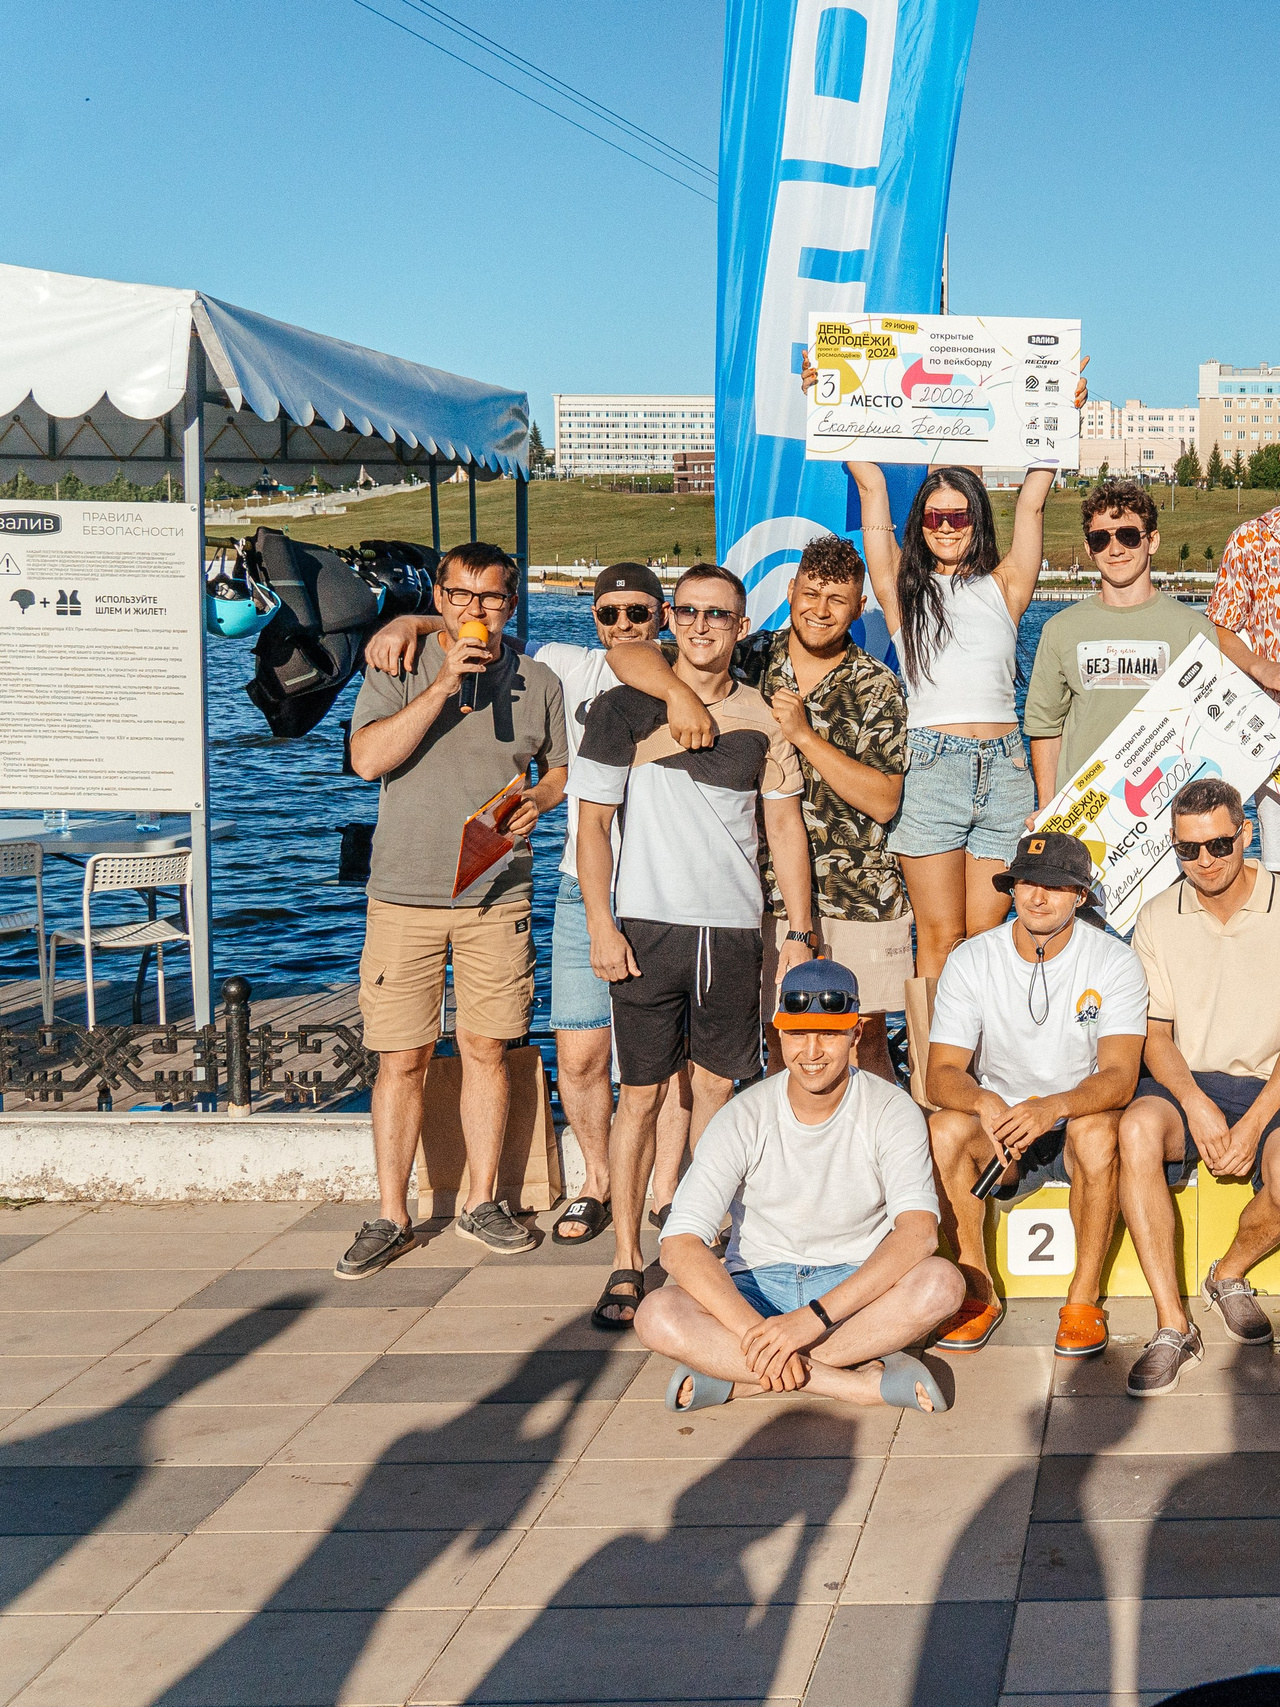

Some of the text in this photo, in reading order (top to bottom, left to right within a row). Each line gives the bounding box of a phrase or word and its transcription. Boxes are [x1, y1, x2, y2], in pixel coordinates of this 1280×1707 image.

[818, 324, 850, 336] ДЕНЬ
[885, 321, 916, 332] 29 ИЮНЯ
[818, 334, 891, 347] МОЛОДЁЖИ
[930, 333, 974, 341] открытые
[867, 348, 896, 359] 2024
[930, 346, 996, 354] соревнования
[944, 358, 992, 368] вейкборду
[821, 374, 835, 399] 3
[850, 395, 903, 408] МЕСТО
[817, 411, 903, 435] Екатерина
[911, 416, 975, 436] Белова
[82, 512, 143, 523] ПРАВИЛА
[82, 526, 184, 537] БЕЗОПАСНОСТИ
[95, 594, 158, 604] ИСПОЛЬЗУЙТЕ
[95, 607, 167, 617] ШЛЕМ И ЖИЛЕТ!
[1086, 657, 1158, 675] БЕЗ ПЛАНА
[1115, 725, 1147, 760] открытые
[1123, 717, 1170, 769] соревнования
[1132, 728, 1177, 778] по вейкборду
[1077, 763, 1102, 788] 29 ИЮНЯ
[1056, 790, 1097, 833] ЛОДЁЖИ
[1085, 794, 1108, 820] 2024
[1041, 815, 1062, 833] ЕНЬ
[1108, 821, 1148, 867] МЕСТО
[1101, 867, 1143, 908] Руслан
[1028, 1223, 1054, 1261] 2
